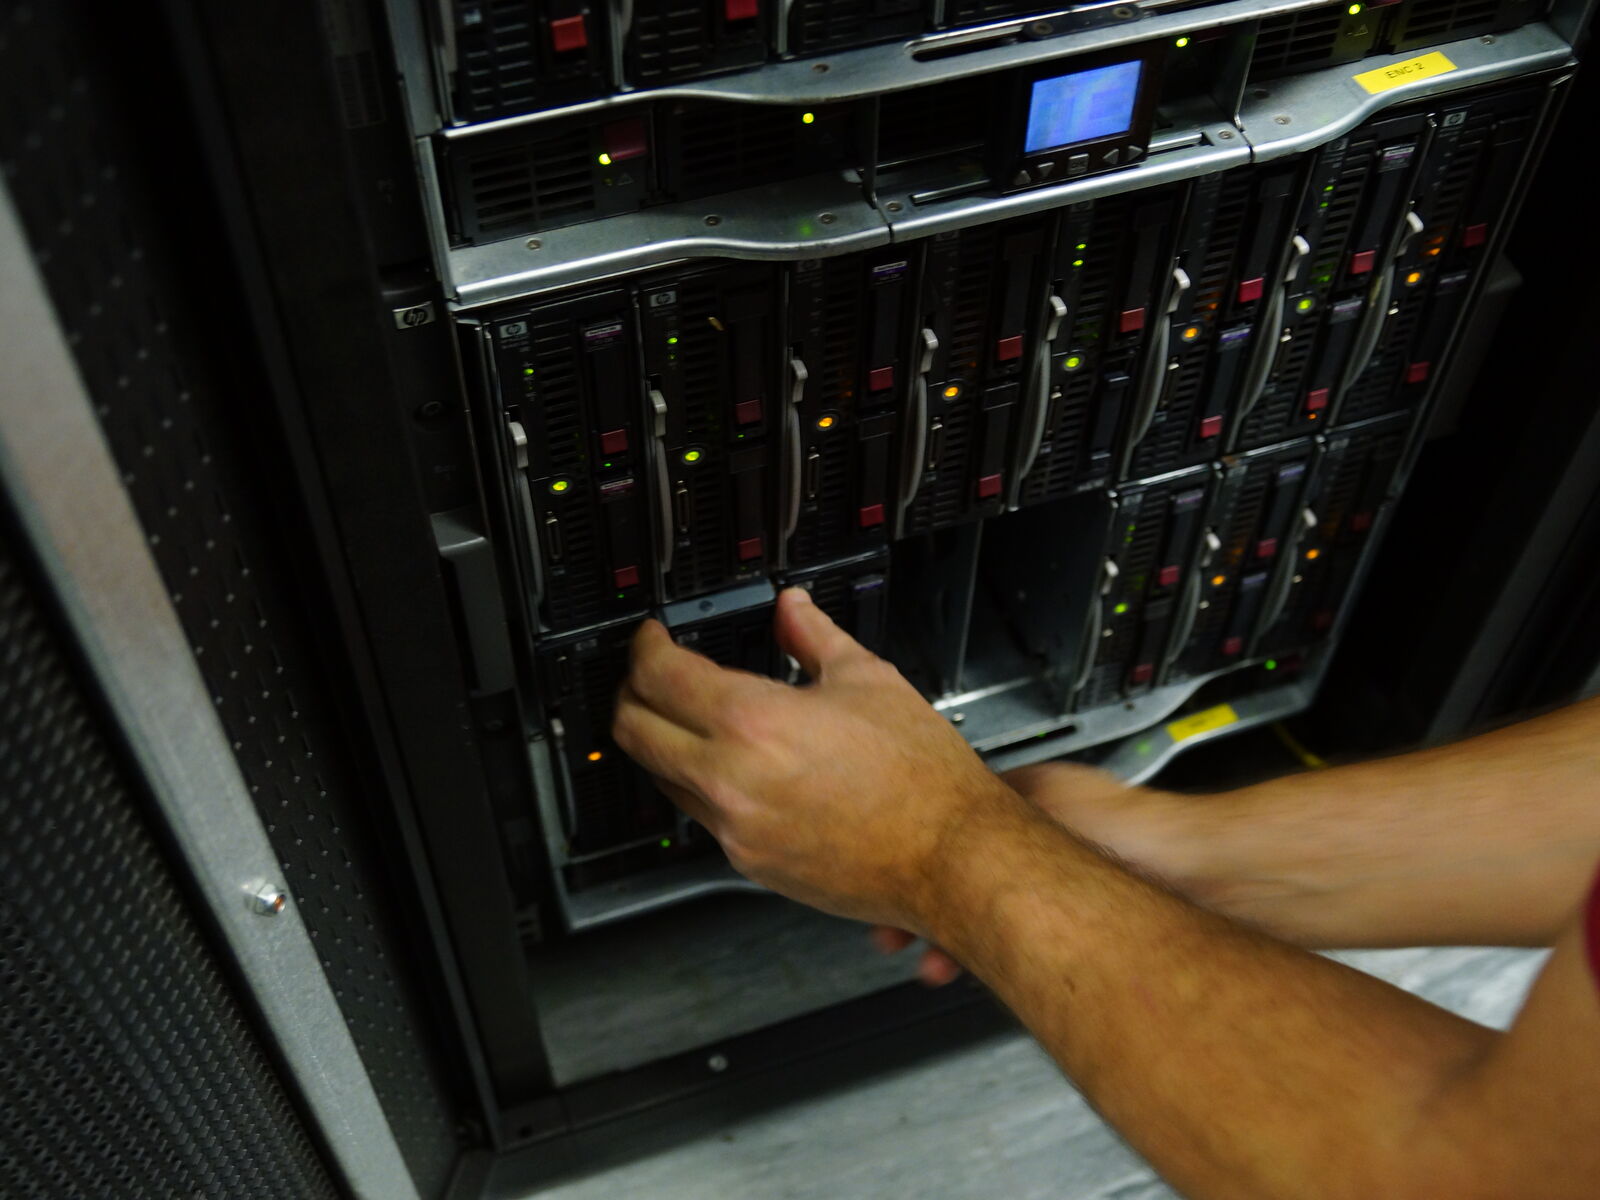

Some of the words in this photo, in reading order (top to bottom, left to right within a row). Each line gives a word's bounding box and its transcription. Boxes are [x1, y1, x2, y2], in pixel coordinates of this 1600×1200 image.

[1385, 66, 1413, 79] ENC
[1414, 62, 1424, 70] 2
[404, 309, 427, 327] hp
